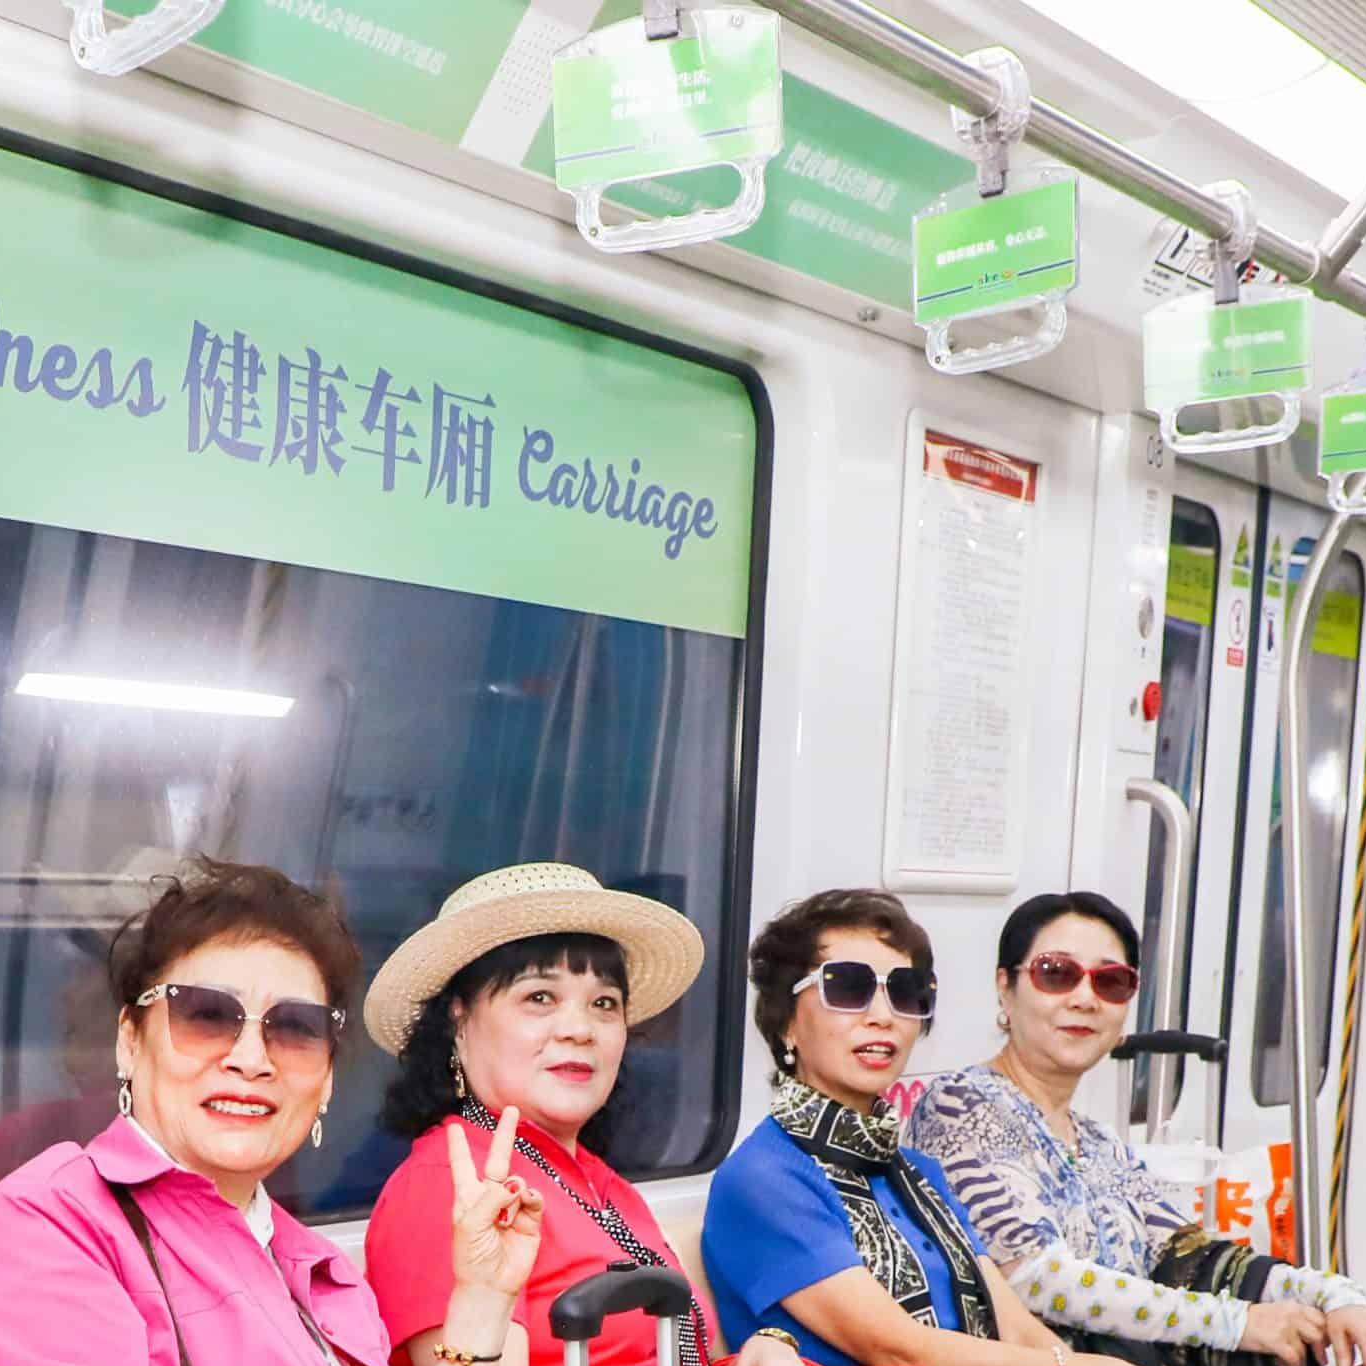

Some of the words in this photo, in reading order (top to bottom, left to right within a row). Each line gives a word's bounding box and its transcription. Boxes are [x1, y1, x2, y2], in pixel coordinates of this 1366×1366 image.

[182, 320, 495, 510] 健康车厢
[517, 425, 717, 559] Carriage
